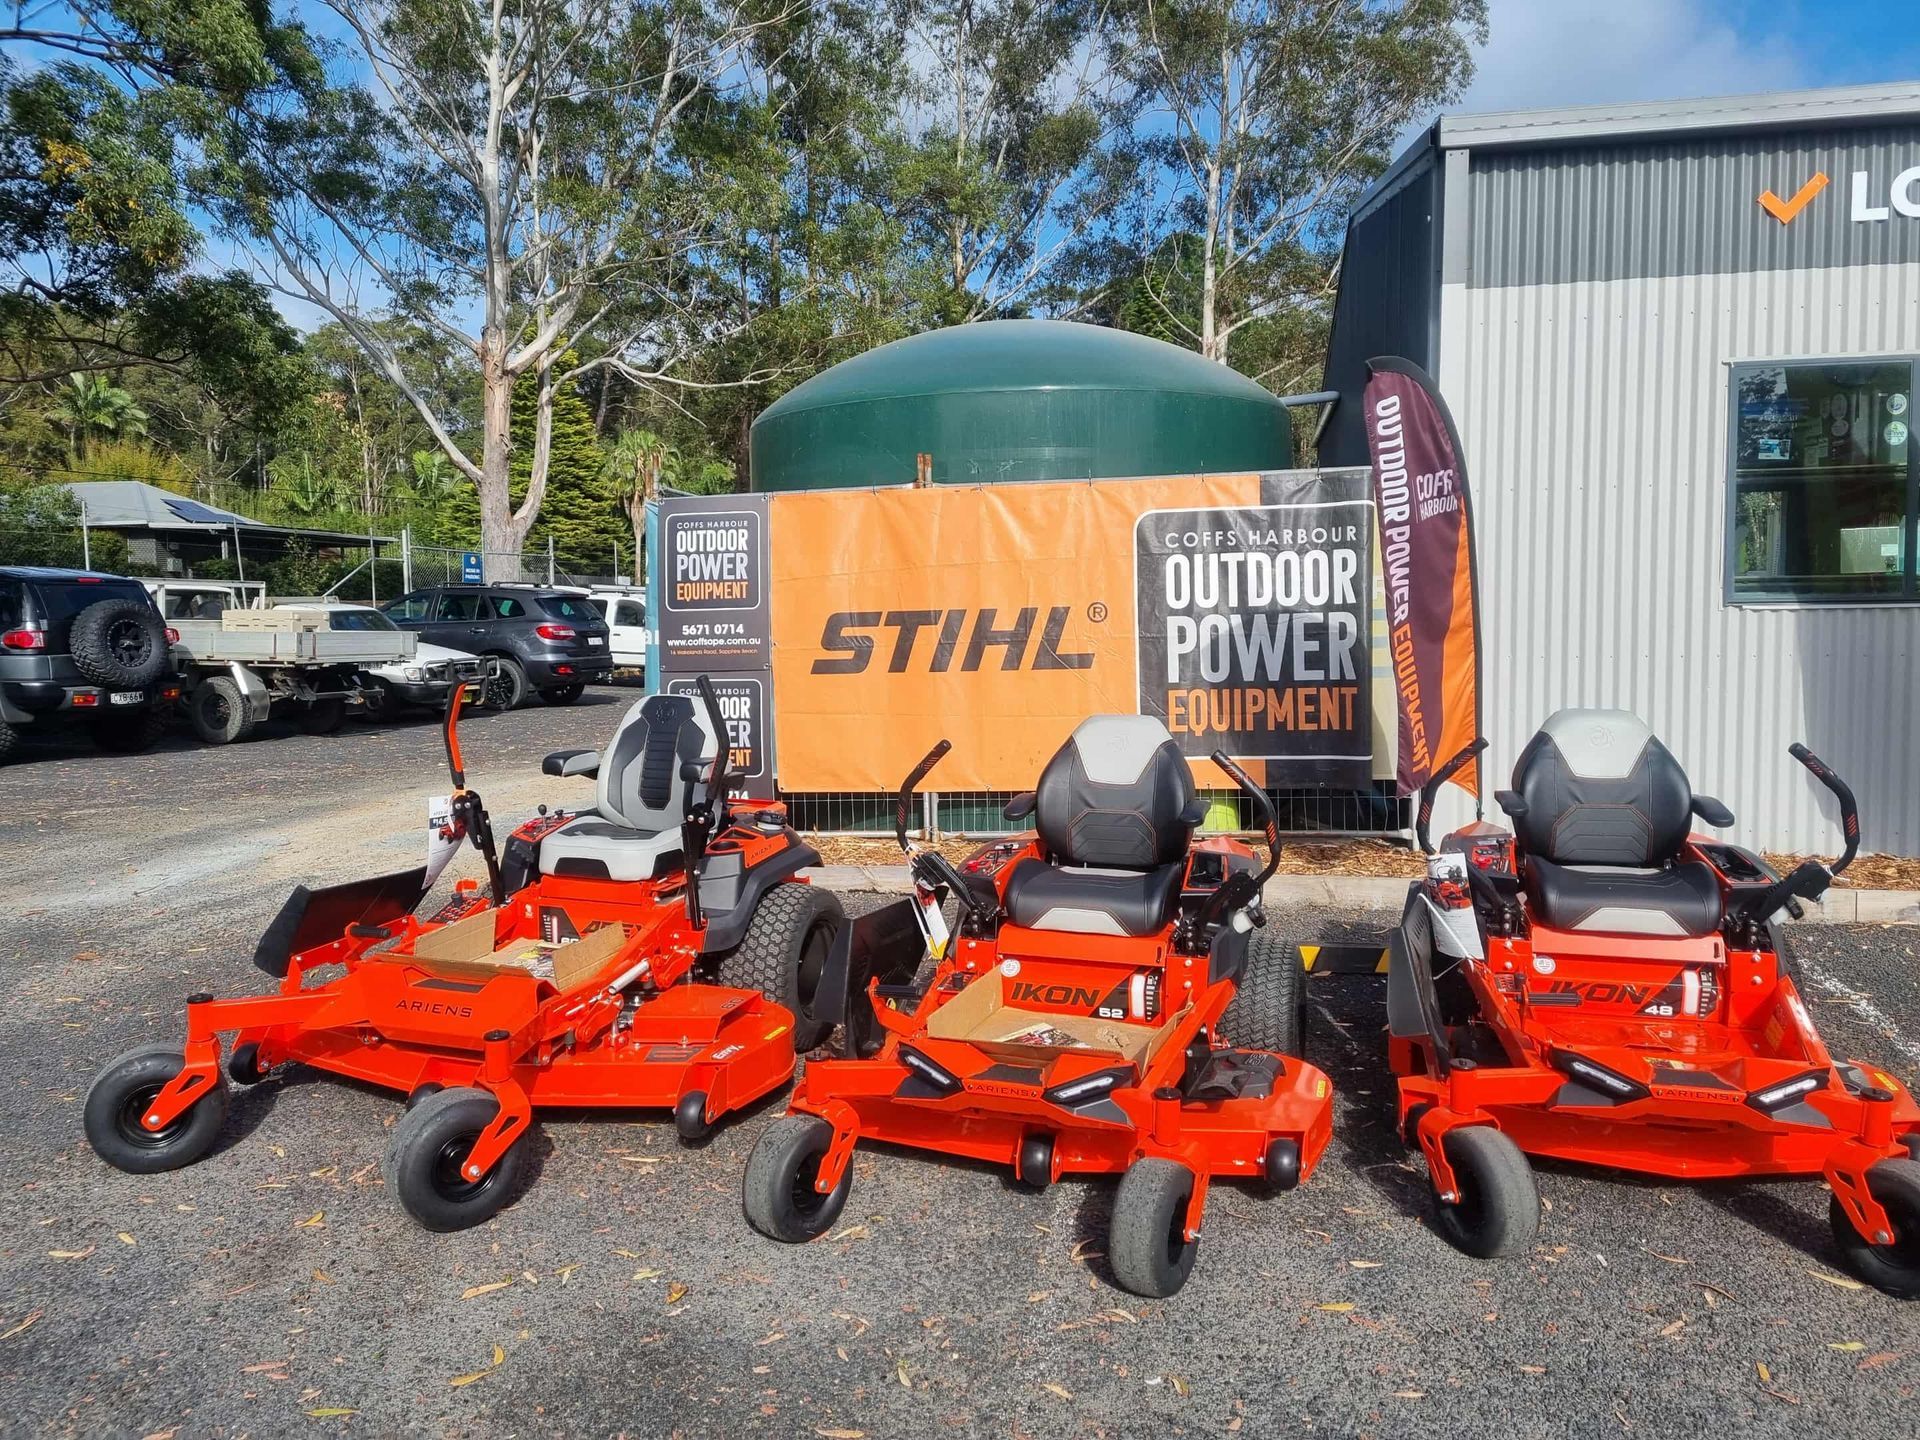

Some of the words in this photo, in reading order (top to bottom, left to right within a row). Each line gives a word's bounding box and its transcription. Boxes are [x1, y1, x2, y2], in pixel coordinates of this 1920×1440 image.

[1376, 395, 1410, 525] OUTDOOR
[707, 520, 748, 528] HARBOUR
[1165, 530, 1237, 548] COFFS
[1249, 525, 1357, 545] HARBOUR
[676, 528, 748, 553] OUTDOOR
[676, 552, 748, 581] POWER
[1165, 548, 1358, 609] OUTDOOR
[1385, 524, 1410, 627] POWER
[676, 581, 748, 602] EQUIPMENT
[667, 637, 760, 647] www.coffsope.com.au
[682, 625, 709, 635] 5671
[713, 624, 744, 634] 0714
[810, 606, 1095, 674] STIHL
[1166, 611, 1358, 684] POWER
[1167, 686, 1358, 737] EQUIPMENT
[1392, 623, 1431, 773] EQUIPMENT
[396, 1000, 472, 1018] ARIENS
[1012, 982, 1100, 1007] IKON
[1098, 1007, 1124, 1019] 52
[1550, 980, 1651, 1005] IKON
[1644, 1005, 1673, 1016] 48
[975, 1084, 1030, 1097] ARIENS
[1666, 1089, 1729, 1101] ARIENS
